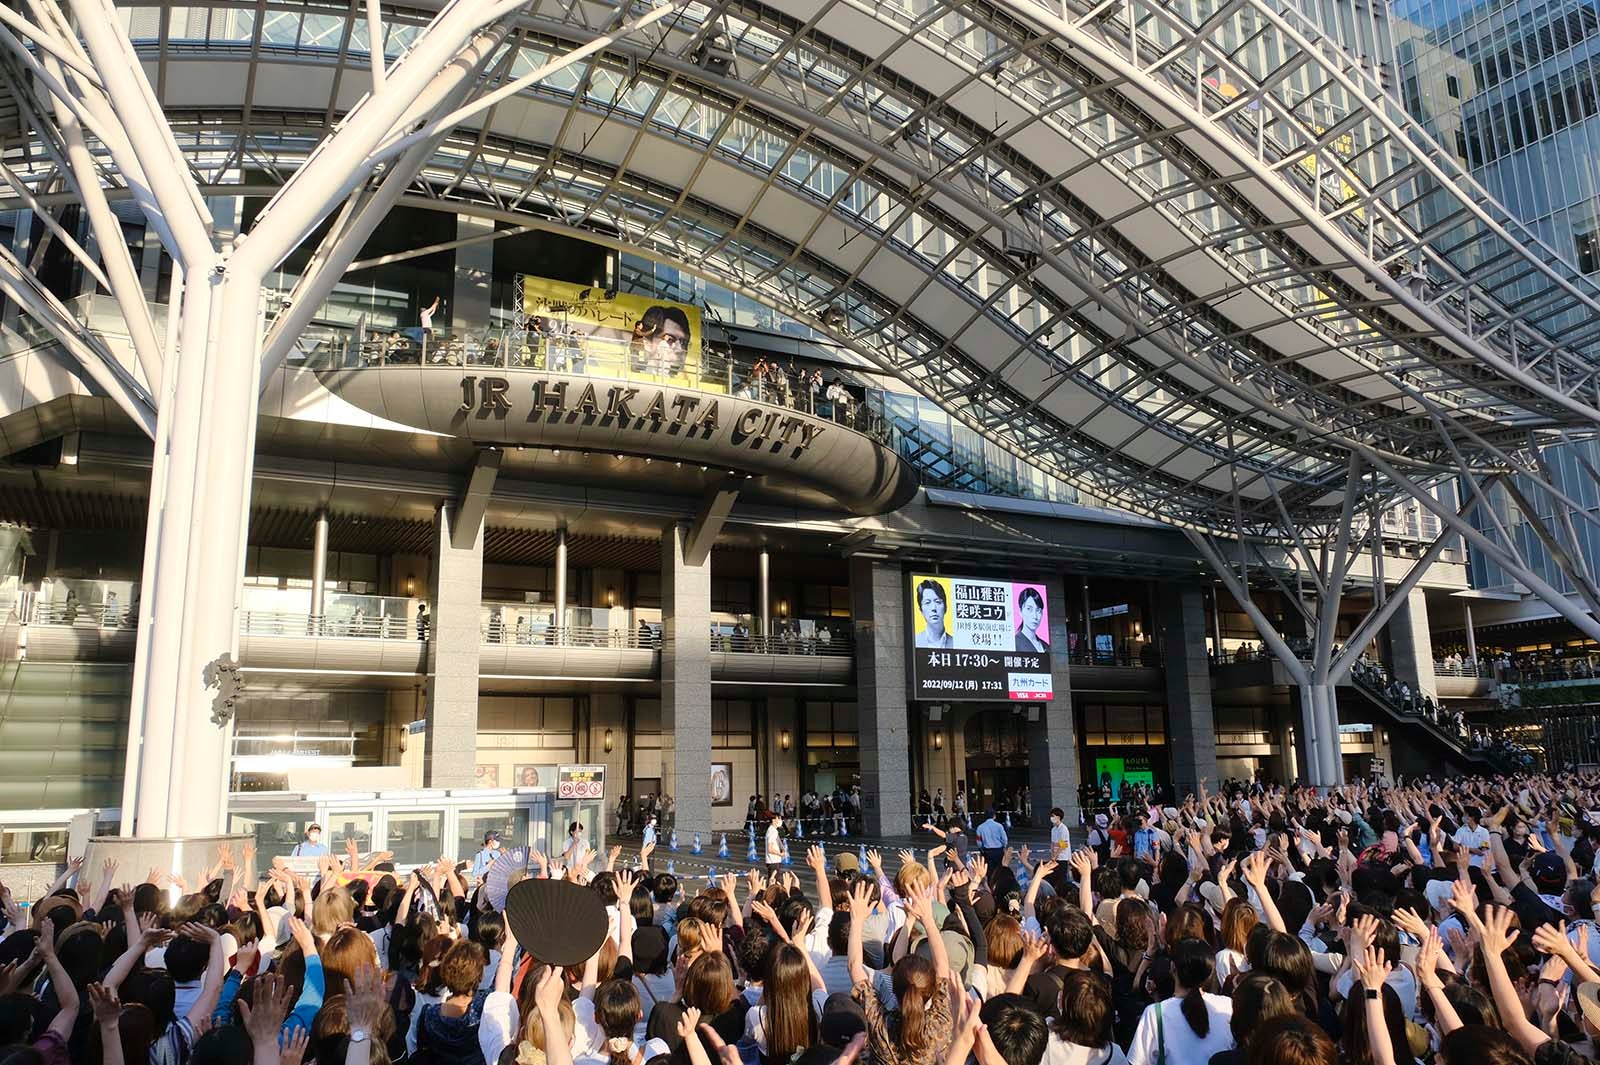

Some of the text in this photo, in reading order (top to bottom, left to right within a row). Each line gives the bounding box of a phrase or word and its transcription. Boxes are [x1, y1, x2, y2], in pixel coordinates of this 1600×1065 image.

[460, 375, 828, 450] JR HAKATA CITY
[927, 651, 951, 668] 本日
[1004, 656, 1040, 669] 開催予定
[922, 679, 964, 691] 2022/09/12
[981, 681, 1003, 690] 17:31
[1012, 678, 1049, 688] 九州カード
